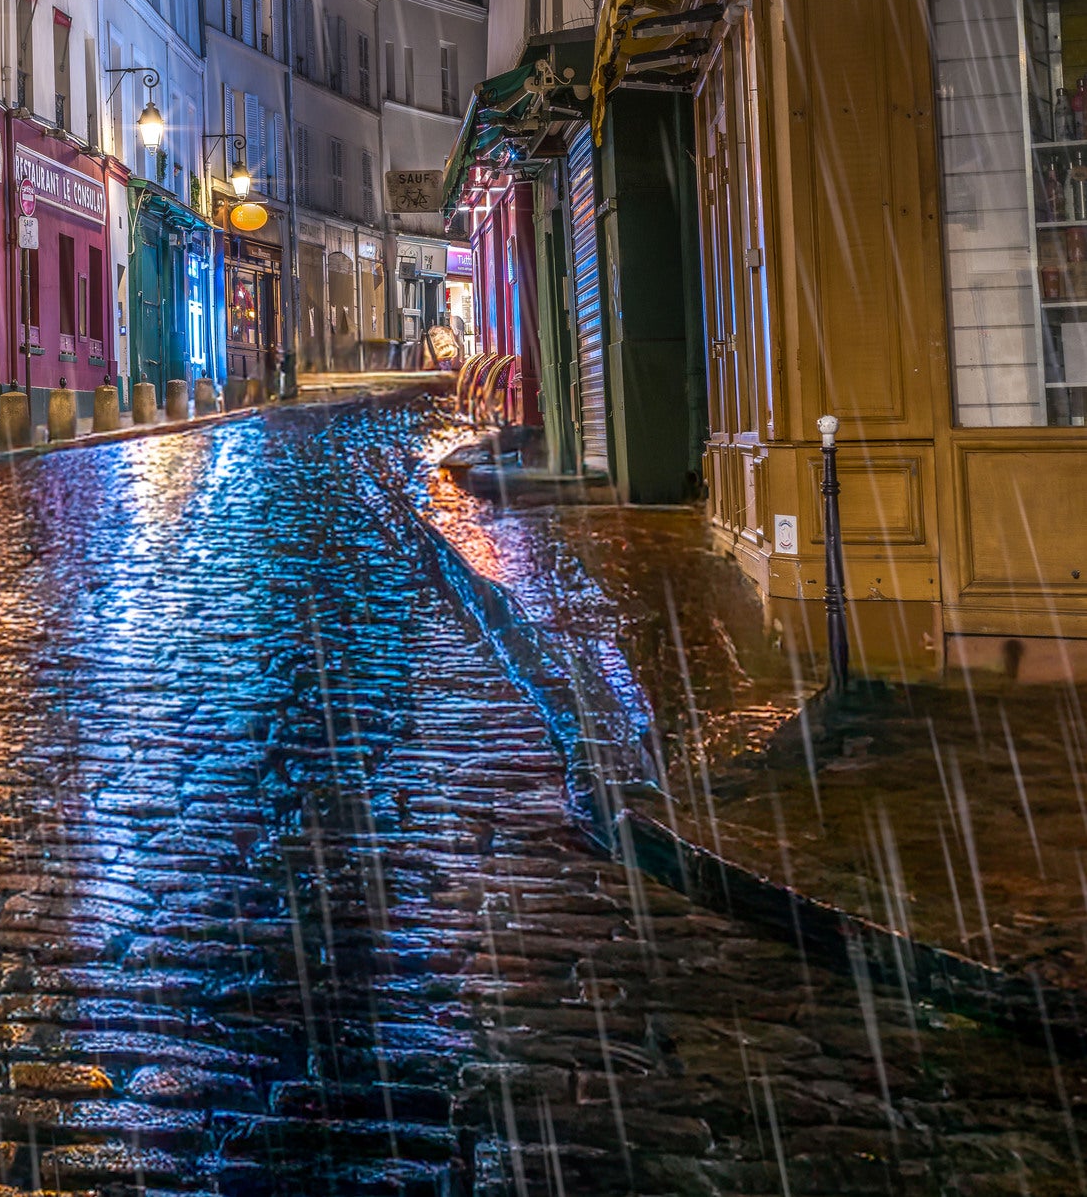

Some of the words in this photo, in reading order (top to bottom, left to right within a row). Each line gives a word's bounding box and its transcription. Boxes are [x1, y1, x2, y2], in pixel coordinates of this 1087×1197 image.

[15, 156, 60, 197] RESTAURANT
[62, 178, 71, 202] LE
[73, 182, 104, 215] CONSULAT
[399, 173, 430, 184] SAUF
